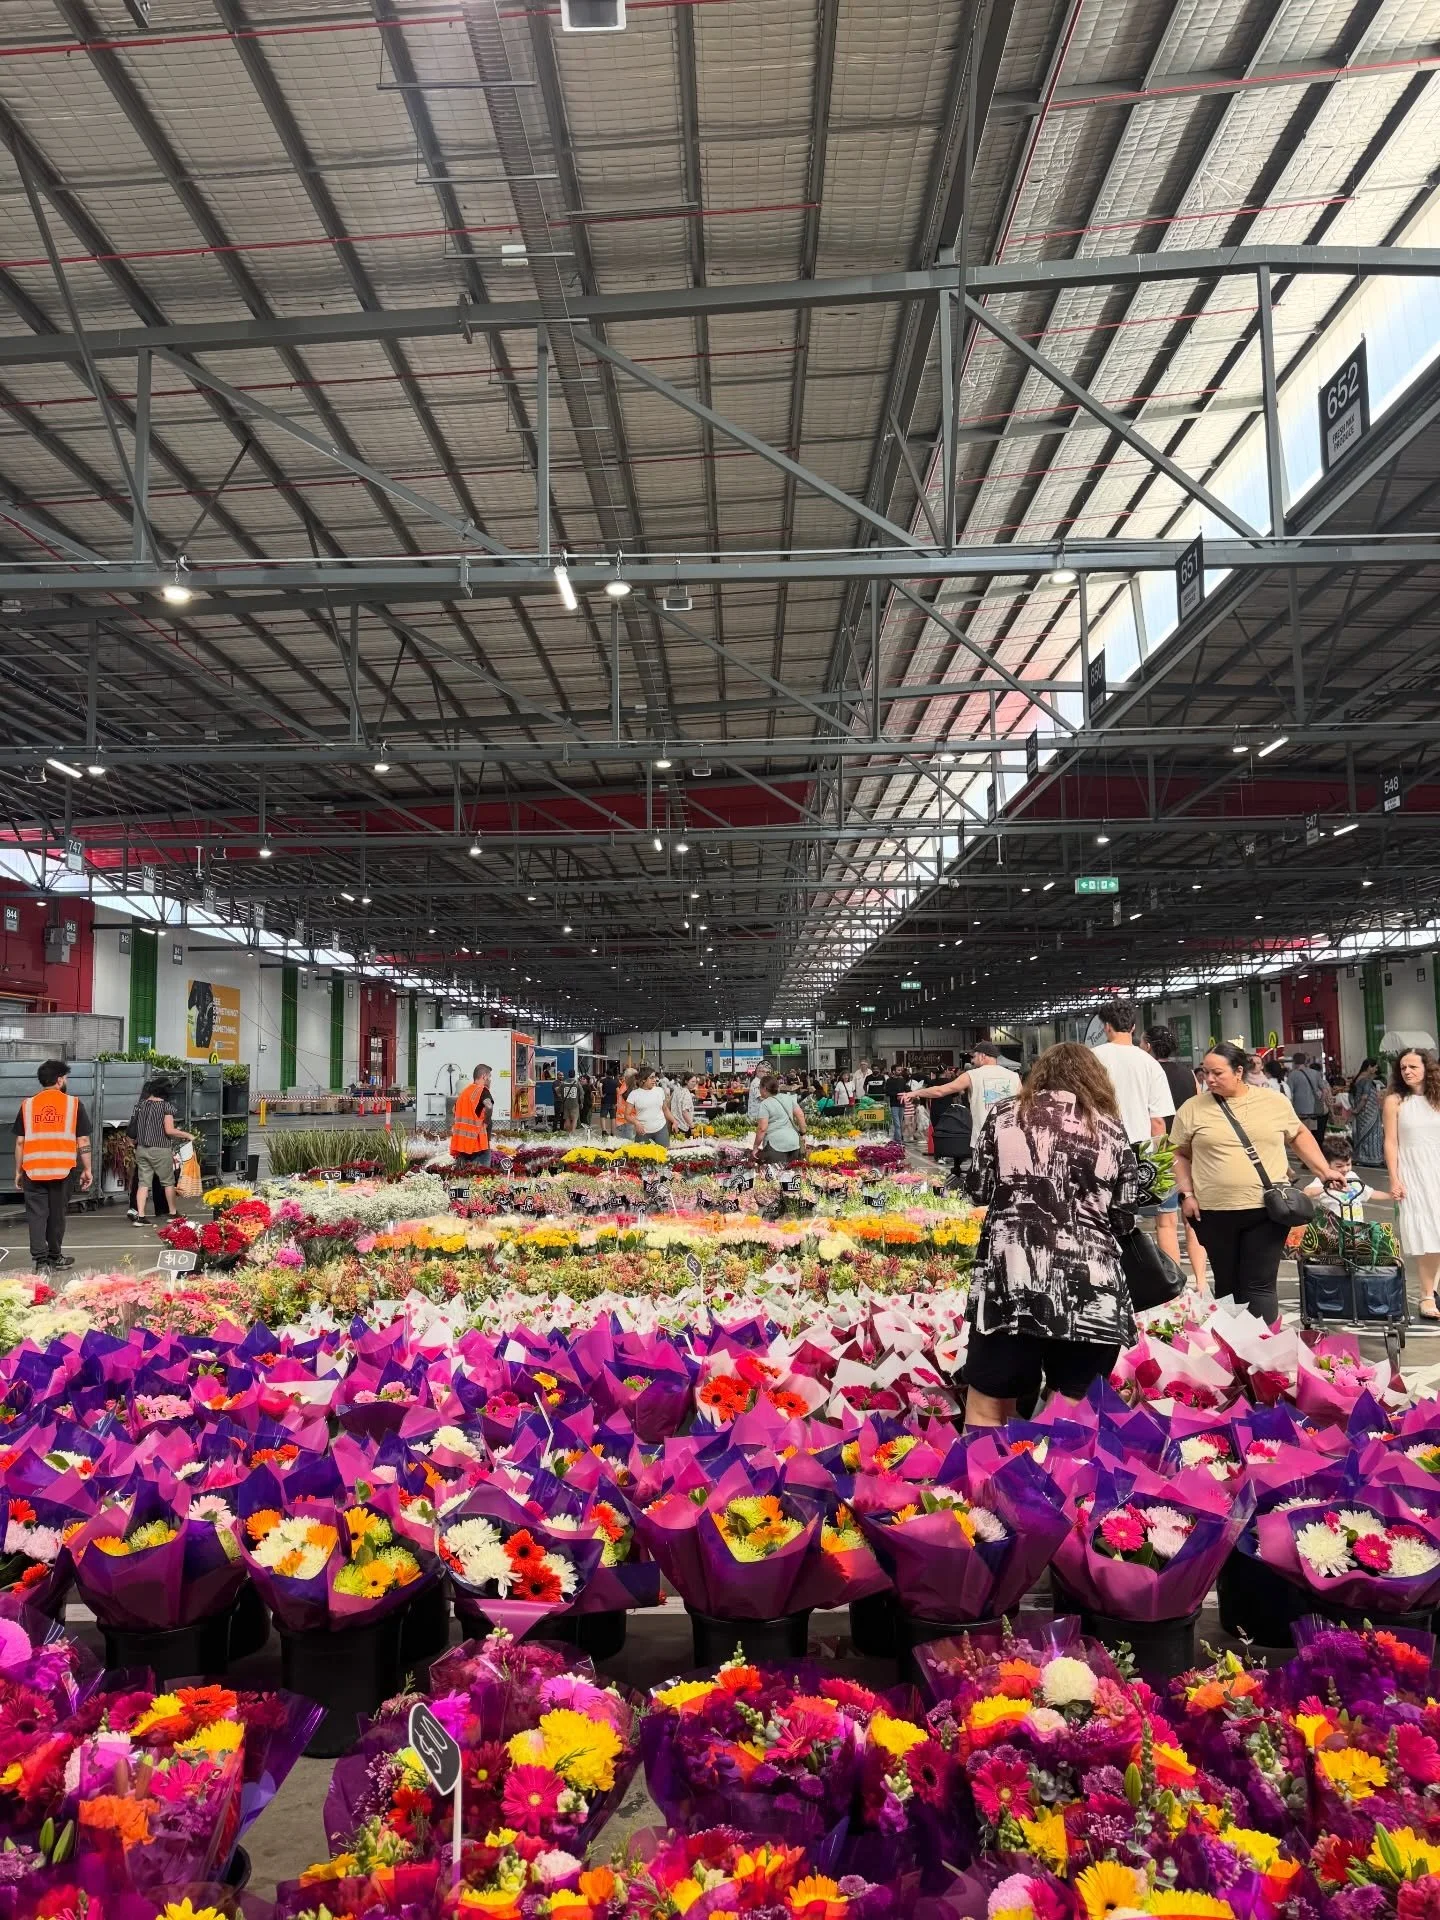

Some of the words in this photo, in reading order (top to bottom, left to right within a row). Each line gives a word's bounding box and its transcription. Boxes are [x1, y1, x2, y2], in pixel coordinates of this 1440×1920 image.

[1327, 361, 1359, 419] 652
[1181, 547, 1198, 585] 651
[1384, 775, 1399, 795] 548
[1305, 813, 1317, 830] 547
[69, 839, 82, 855] 747
[144, 865, 155, 879] 746
[6, 908, 17, 920] 844
[66, 921, 76, 932] 843
[212, 1007, 239, 1017] SOMETHING?
[212, 1016, 221, 1024] SAY
[164, 1251, 188, 1267] $10
[414, 1715, 448, 1774] $10
